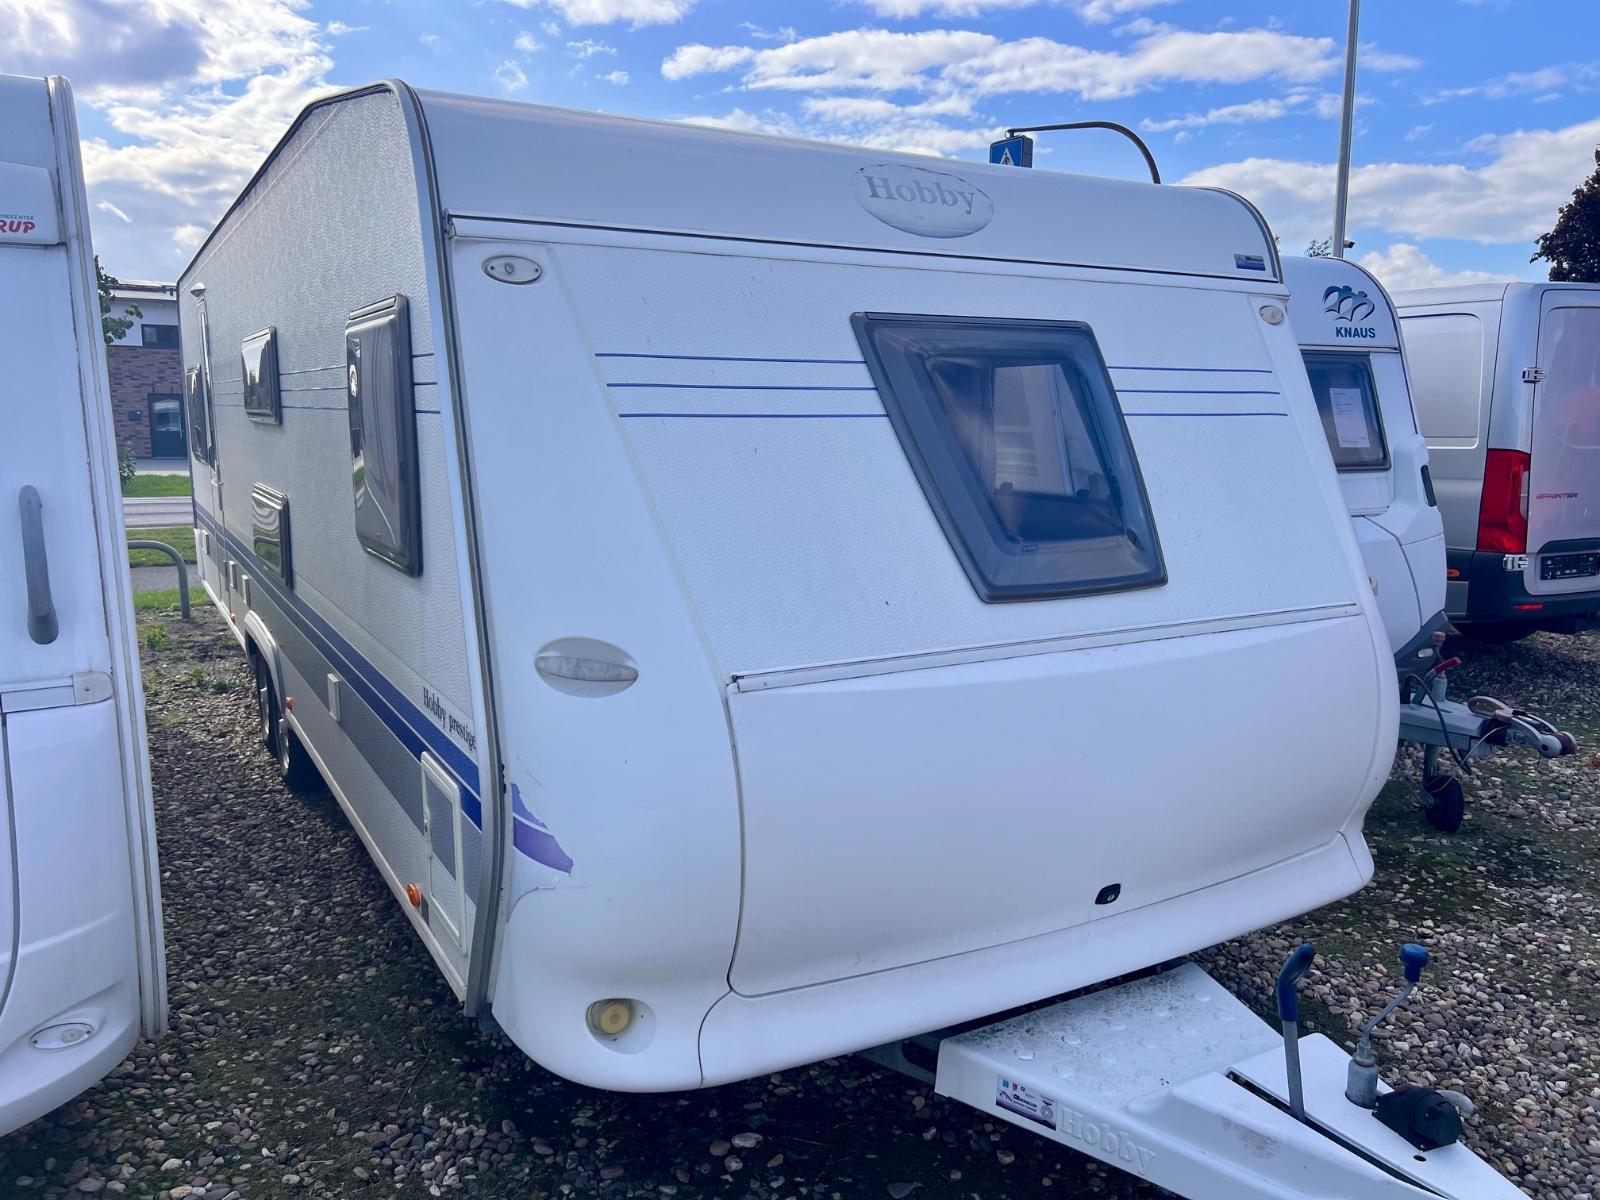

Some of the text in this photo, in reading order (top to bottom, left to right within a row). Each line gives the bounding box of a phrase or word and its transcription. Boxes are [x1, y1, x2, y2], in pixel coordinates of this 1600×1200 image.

[865, 175, 975, 216] Hobby
[0, 220, 36, 233] RUP
[1335, 326, 1376, 339] KNAUS
[1536, 492, 1578, 500] SPRINTER
[423, 686, 477, 751] Hobby prestige
[1061, 1107, 1157, 1176] Hobby
